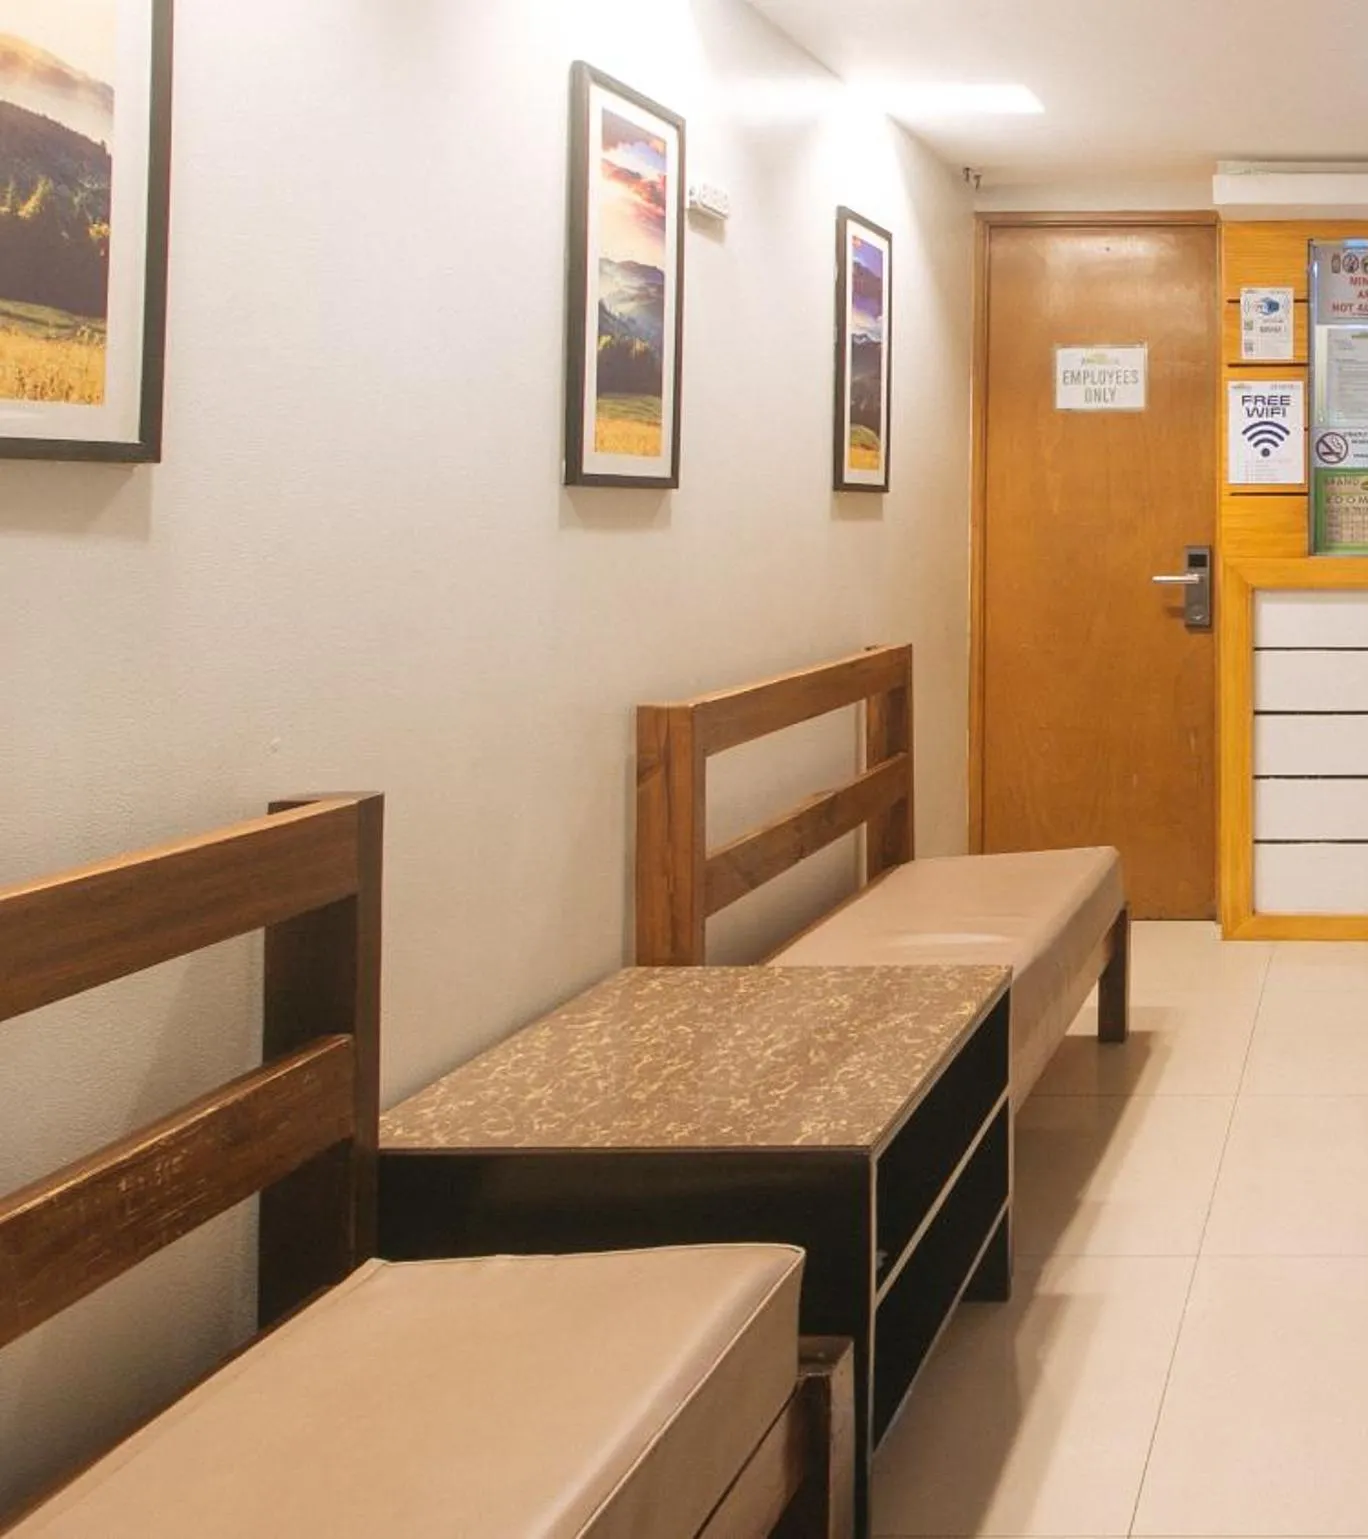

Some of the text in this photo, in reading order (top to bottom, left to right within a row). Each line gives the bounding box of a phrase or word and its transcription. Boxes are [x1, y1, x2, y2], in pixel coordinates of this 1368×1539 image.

[1332, 303, 1353, 312] NOT
[1062, 369, 1139, 385] EMPLOYEES
[1083, 387, 1117, 404] ONLY
[1241, 395, 1291, 406] FREE
[1245, 407, 1287, 418] WIFI
